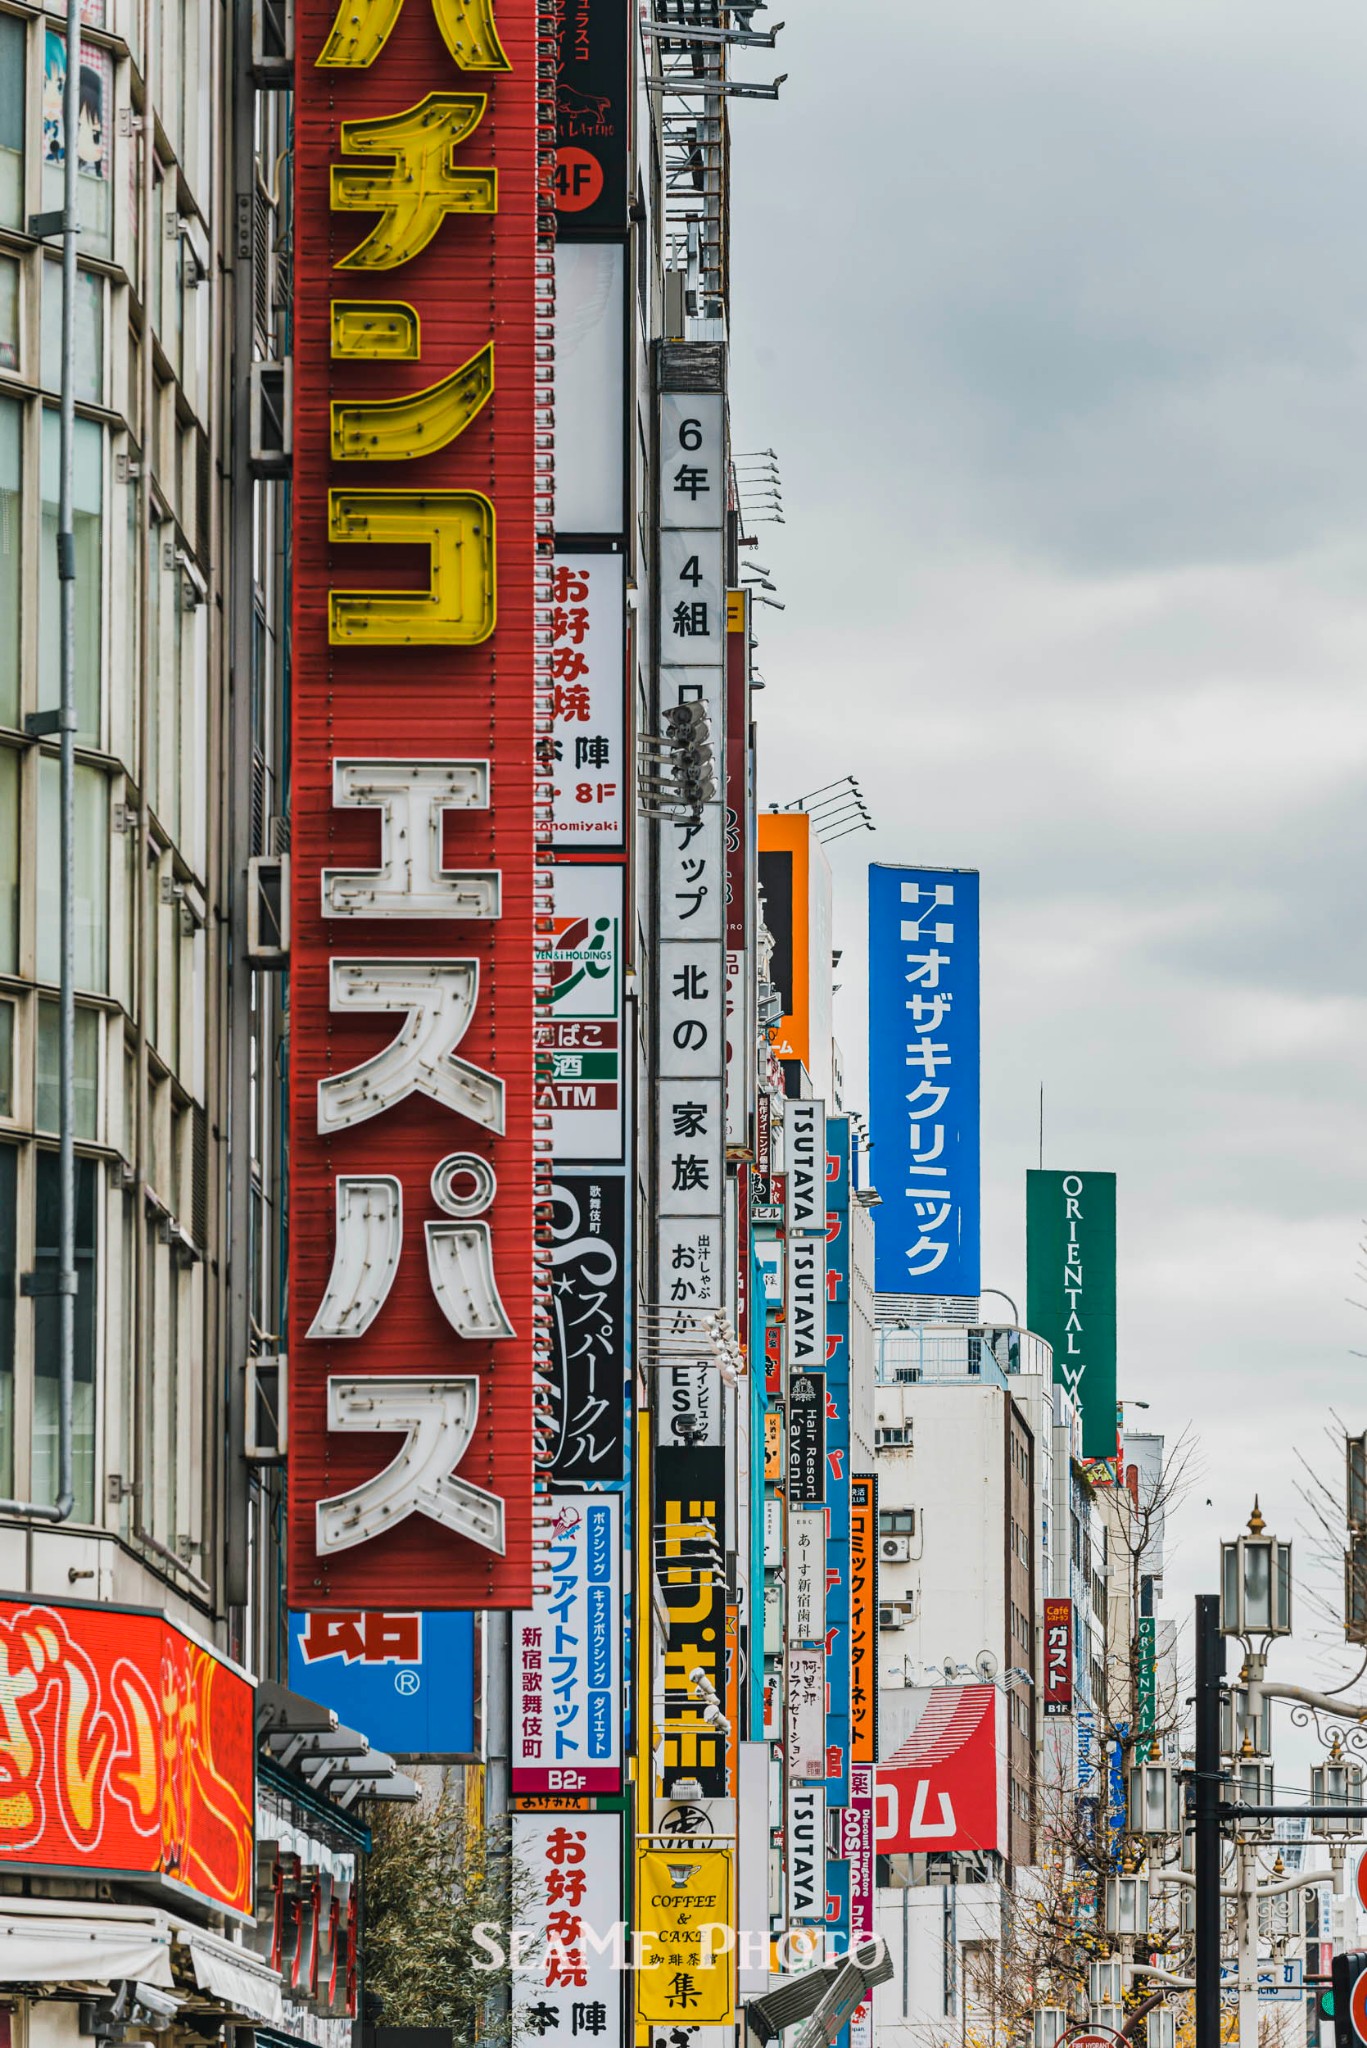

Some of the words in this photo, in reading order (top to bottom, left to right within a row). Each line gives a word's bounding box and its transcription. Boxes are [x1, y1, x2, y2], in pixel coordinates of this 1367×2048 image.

[555, 164, 591, 195] 4F
[566, 951, 612, 960] HOLDINGS
[553, 1054, 583, 1077] 酒
[538, 1086, 597, 1107] ATM
[905, 948, 952, 1276] オザキクリニック
[305, 757, 517, 1557] エスパス
[794, 1107, 814, 1221] TSUTAYA
[589, 1185, 601, 1234] 歌舞伎町
[698, 1234, 711, 1299] 出汁しゃぶ
[1062, 1175, 1084, 1354] ORIENTAL
[794, 1244, 814, 1358] TSUTAYA
[563, 1291, 617, 1468] スパークル
[806, 1409, 817, 1441] Hair
[806, 1447, 817, 1498] Resort
[593, 1512, 605, 1576] ボクシング
[797, 1533, 811, 1638] あーす新宿歯科
[1047, 1606, 1069, 1615] Café
[548, 1546, 579, 1760] ファイトフィット
[593, 1590, 605, 1686] キックボクシング
[852, 1517, 866, 1744] コミック・インターネット
[1048, 1625, 1068, 1690] ガスト
[522, 1627, 543, 1759] 新宿歌舞伎町
[1048, 1705, 1068, 1713] B1F
[593, 1697, 605, 1754] ダイエット
[548, 1770, 586, 1790] B2F
[852, 1773, 868, 1796] 薬
[794, 1794, 814, 1910] TSUTAYA
[545, 1827, 587, 1987] お好み焼
[651, 1895, 717, 1908] COFFEE
[677, 1913, 691, 1924] &
[658, 1930, 708, 1943] CAKE
[664, 1972, 702, 2009] 集
